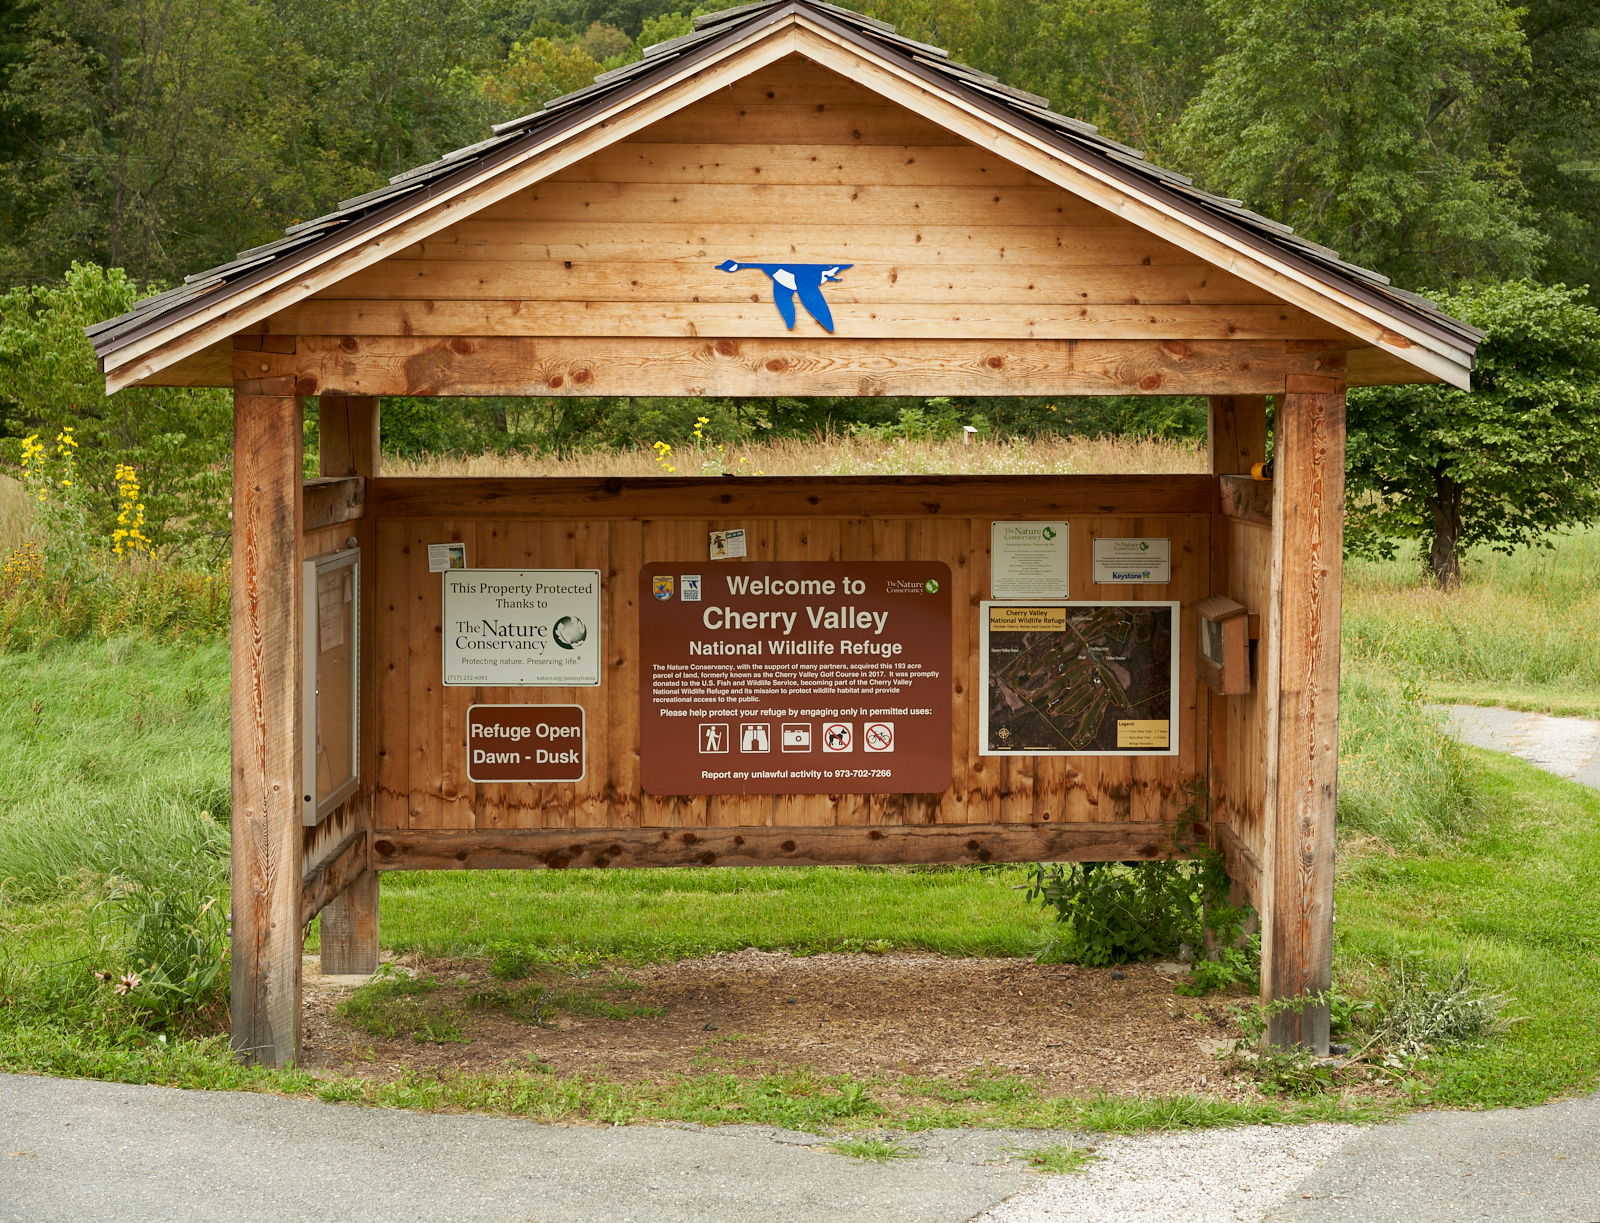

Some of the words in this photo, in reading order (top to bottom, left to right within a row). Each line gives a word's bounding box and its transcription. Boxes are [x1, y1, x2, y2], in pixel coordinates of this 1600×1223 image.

[1113, 572, 1143, 580] Keystone
[451, 583, 476, 593] This
[480, 583, 532, 596] Property
[536, 584, 592, 593] Protected
[726, 576, 835, 595] Welcome
[843, 577, 865, 594] to
[886, 587, 924, 595] Conservancy
[496, 599, 534, 608] Thanks
[703, 607, 797, 635] Cherry
[806, 606, 888, 634] Valley
[456, 621, 480, 633] The
[481, 620, 548, 637] Nature
[456, 636, 548, 655] Conservancy
[690, 641, 761, 655] National
[768, 640, 834, 654] Wildlife
[841, 640, 902, 658] Refuge
[462, 657, 497, 666] Protecting
[527, 657, 563, 666] Preserving
[690, 709, 707, 718] help
[709, 709, 738, 718] protect
[760, 708, 786, 717] refuge
[789, 708, 798, 717] by
[800, 708, 838, 717] engaging
[840, 708, 858, 717] only
[870, 708, 908, 717] permitted
[472, 724, 531, 741] Refuge
[536, 723, 580, 741] Open
[474, 750, 520, 763] Dawn
[537, 749, 579, 763] Dusk
[702, 771, 731, 780] Report
[790, 770, 821, 779] activity
